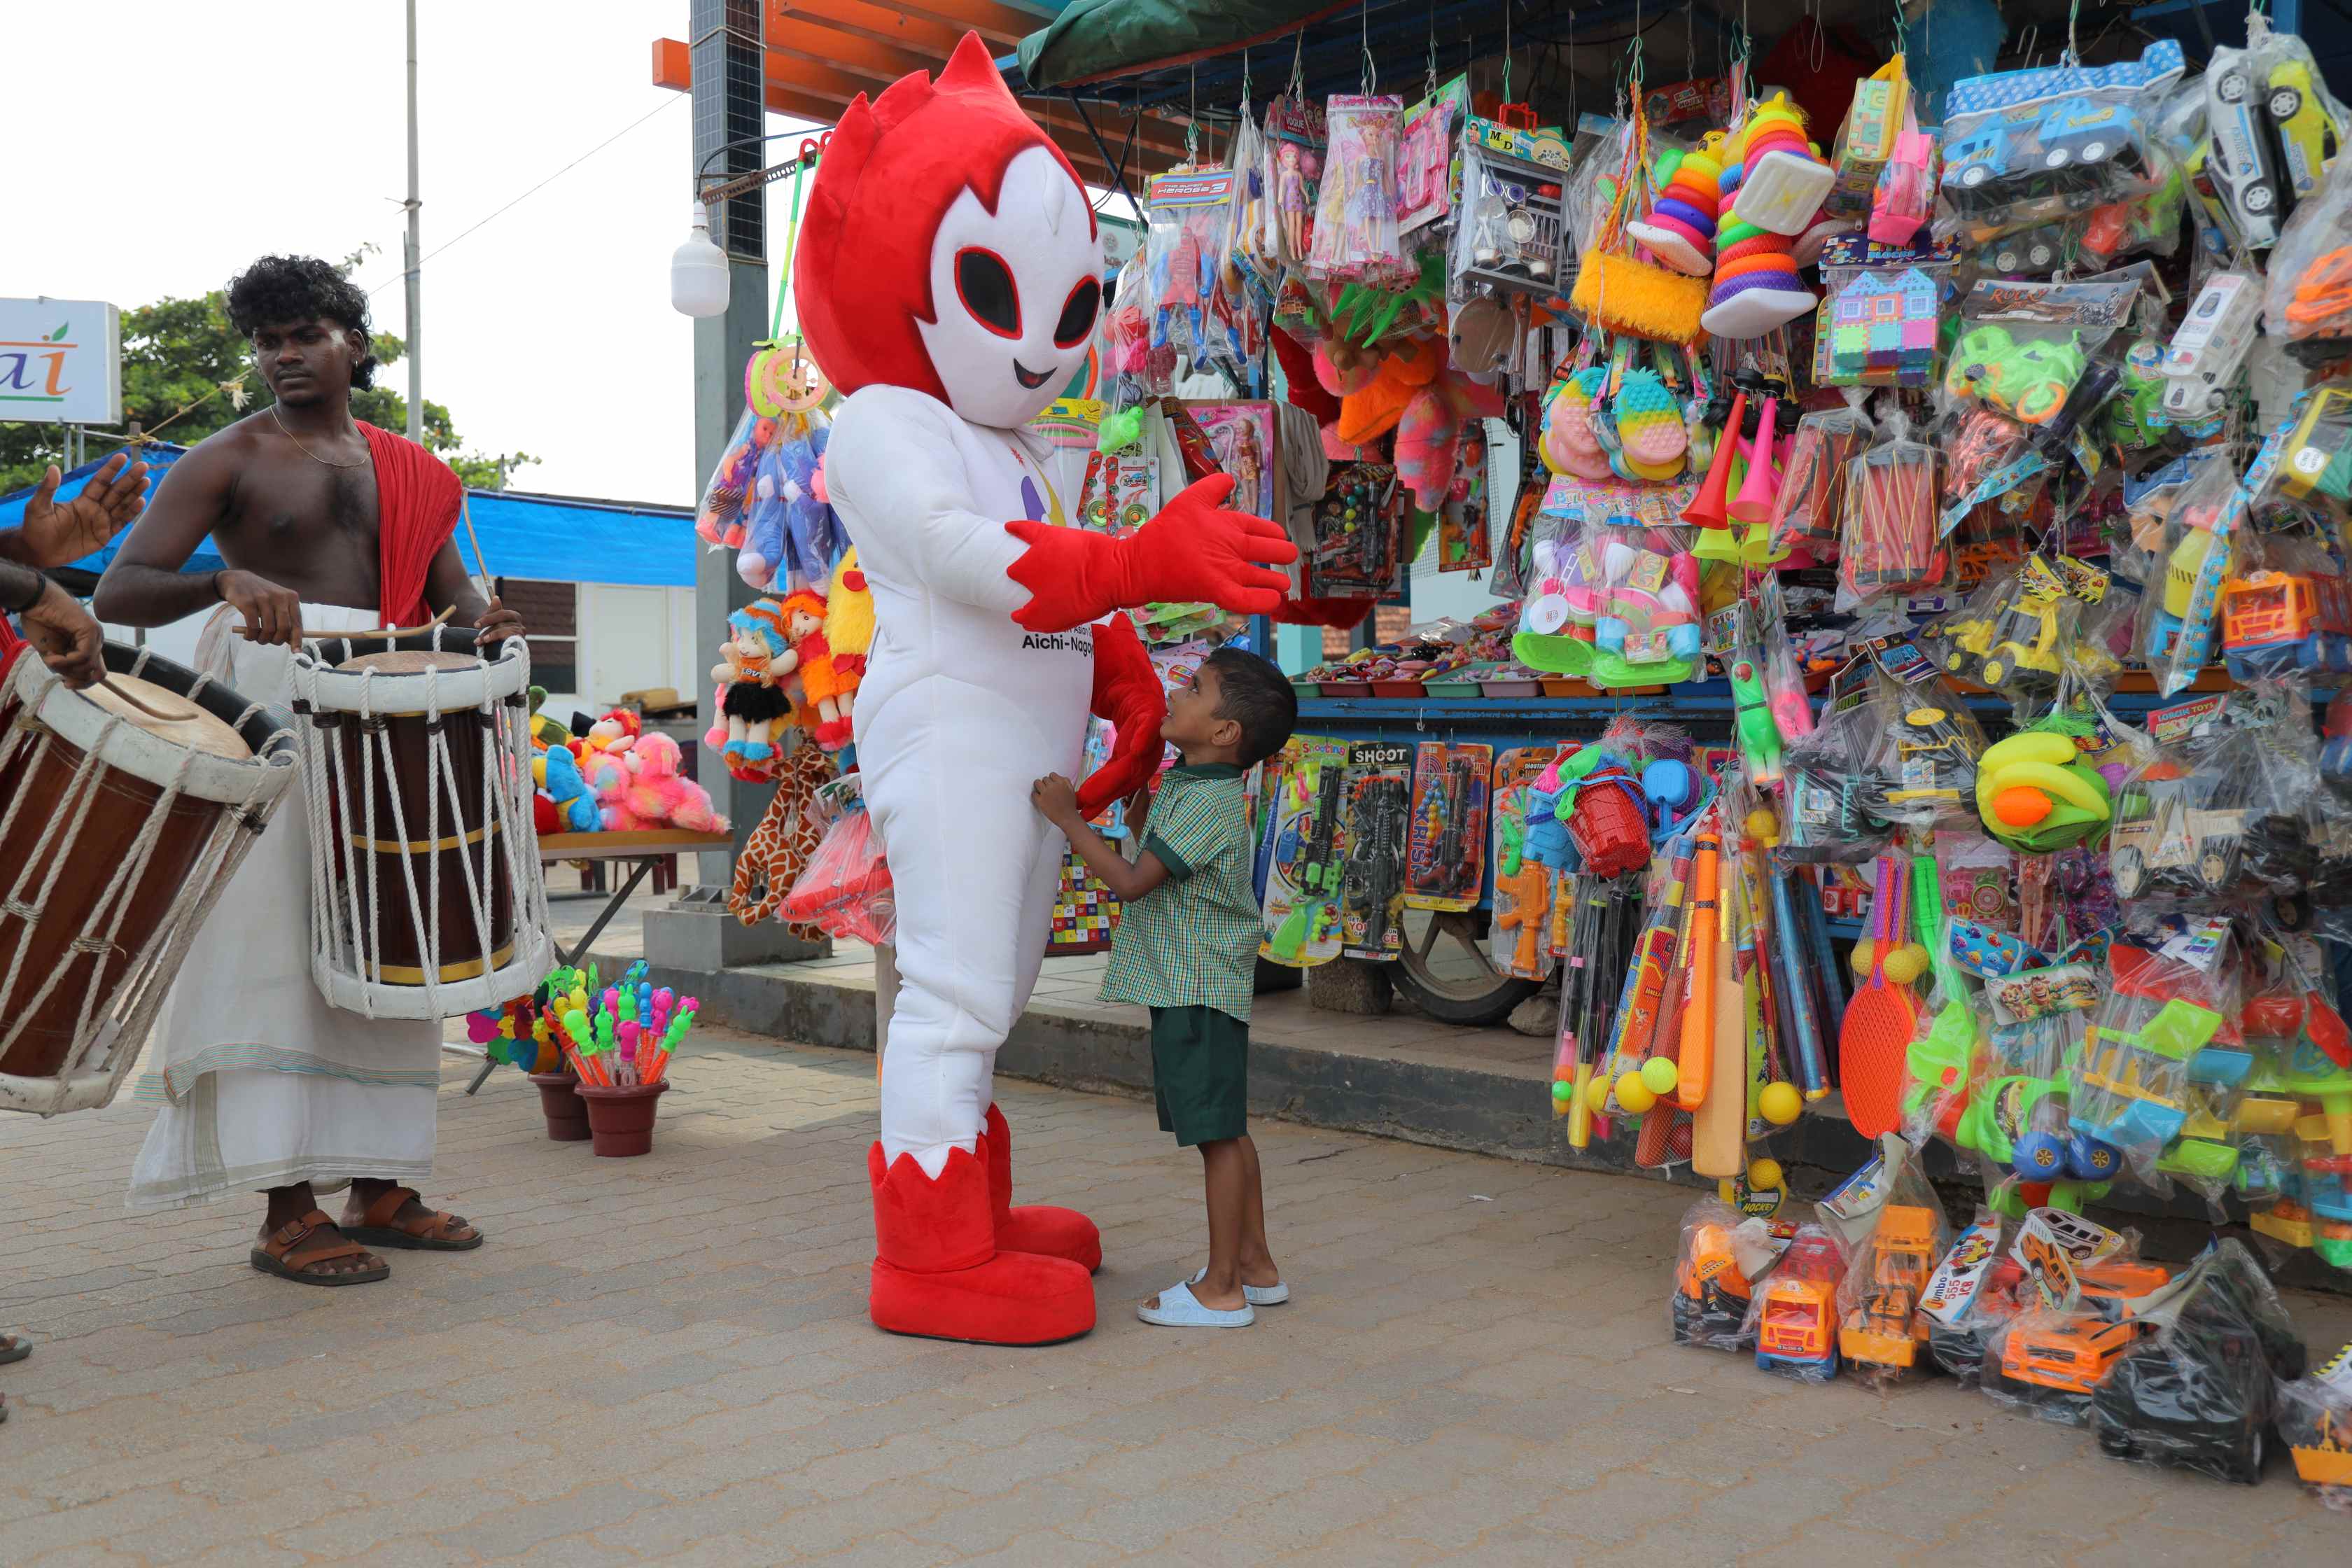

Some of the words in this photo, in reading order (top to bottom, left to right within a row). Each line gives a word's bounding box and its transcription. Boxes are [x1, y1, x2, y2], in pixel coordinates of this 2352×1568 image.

[1210, 182, 1227, 193] 3
[2191, 701, 2215, 713] TOYS
[1355, 748, 1407, 763] SHOOT
[1741, 1203, 1775, 1212] HOCKEY
[1925, 1276, 1947, 1308] jumbo
[1945, 1279, 1961, 1300] 555
[1958, 1280, 1975, 1296] JCB
